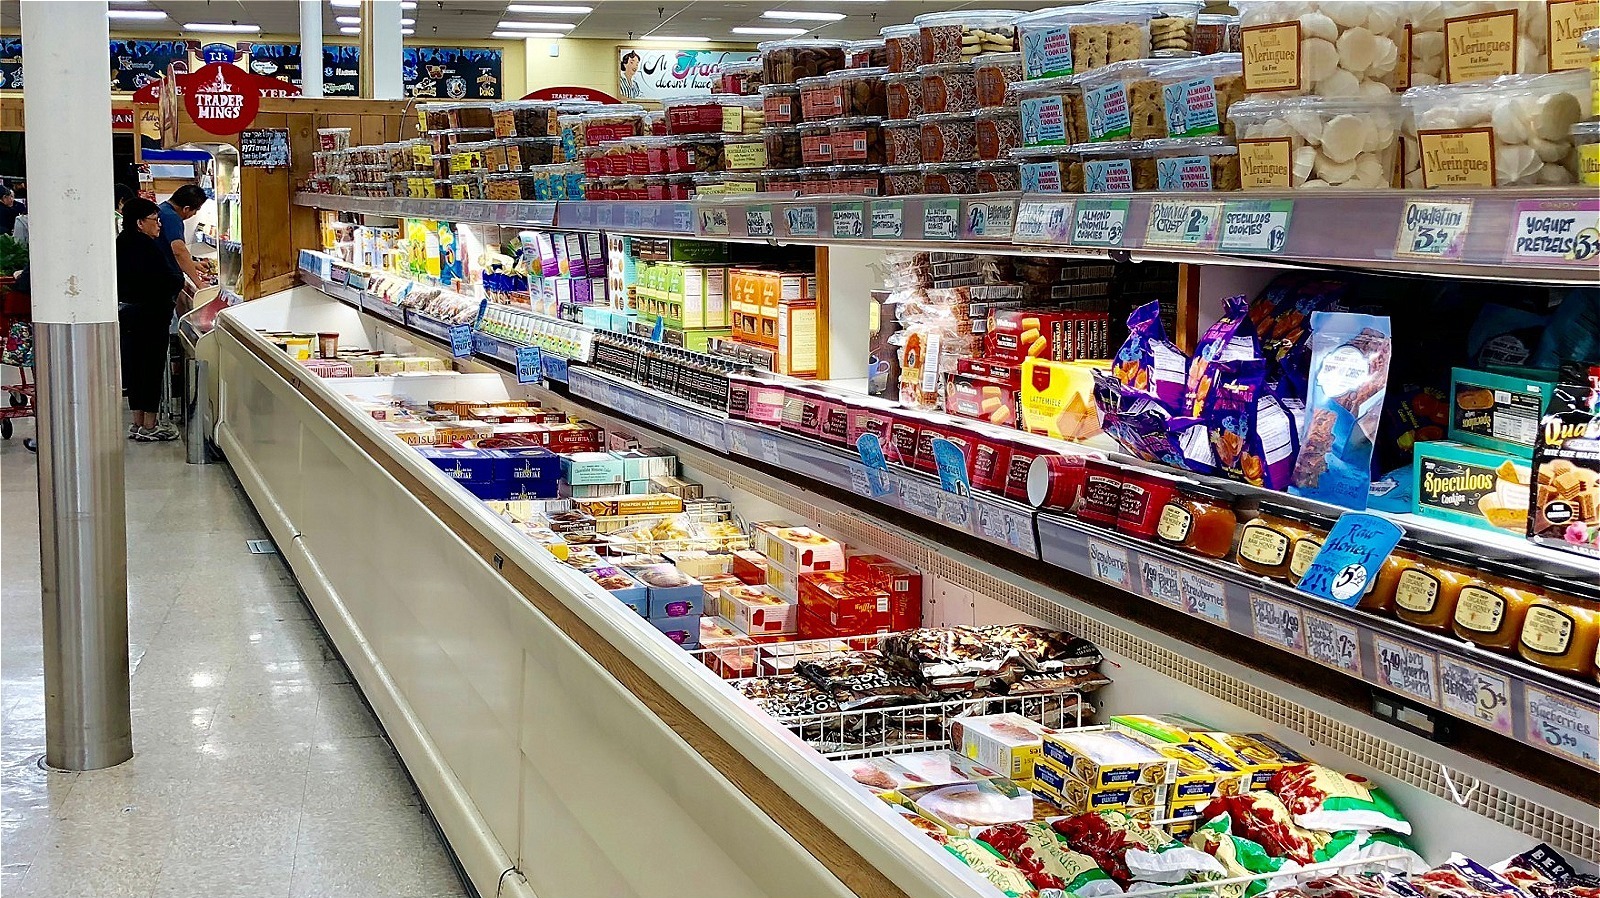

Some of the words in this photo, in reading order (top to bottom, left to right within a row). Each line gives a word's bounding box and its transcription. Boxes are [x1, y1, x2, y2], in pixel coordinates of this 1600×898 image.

[1451, 35, 1510, 57] Meringues
[1247, 44, 1295, 65] Meringues
[671, 51, 730, 79] Trad
[1187, 86, 1211, 96] ALMOND
[195, 94, 244, 107] TRADER
[1186, 93, 1214, 104] WINDMILL
[197, 106, 240, 119] MINGS
[1188, 101, 1214, 111] COOKIES
[1242, 156, 1288, 178] Meringues
[1426, 149, 1488, 174] Meringues
[1182, 165, 1206, 173] ALMOND
[1106, 175, 1130, 183] WINDMILL
[1180, 173, 1209, 181] WINDMILL
[1082, 211, 1111, 221] ALMOND
[1226, 213, 1271, 224] SPECULOOS
[1407, 204, 1462, 230] Quadratini
[1077, 220, 1109, 231] WINDMILL
[1228, 224, 1263, 235] COOKIES
[1526, 217, 1575, 234] YOGURT
[1077, 230, 1103, 239] COOKIES
[1516, 236, 1574, 253] PRETZELS
[1029, 396, 1061, 407] LATTEMIELE
[1424, 468, 1493, 498] Speculoos
[1441, 493, 1466, 505] Cookies
[1252, 533, 1274, 544] ORGANIC
[1347, 523, 1384, 543] Raw
[1090, 543, 1127, 570] Strawberries
[1322, 535, 1378, 565] Honey
[1181, 578, 1224, 606] Strawberries
[1530, 701, 1590, 734] Blueberries
